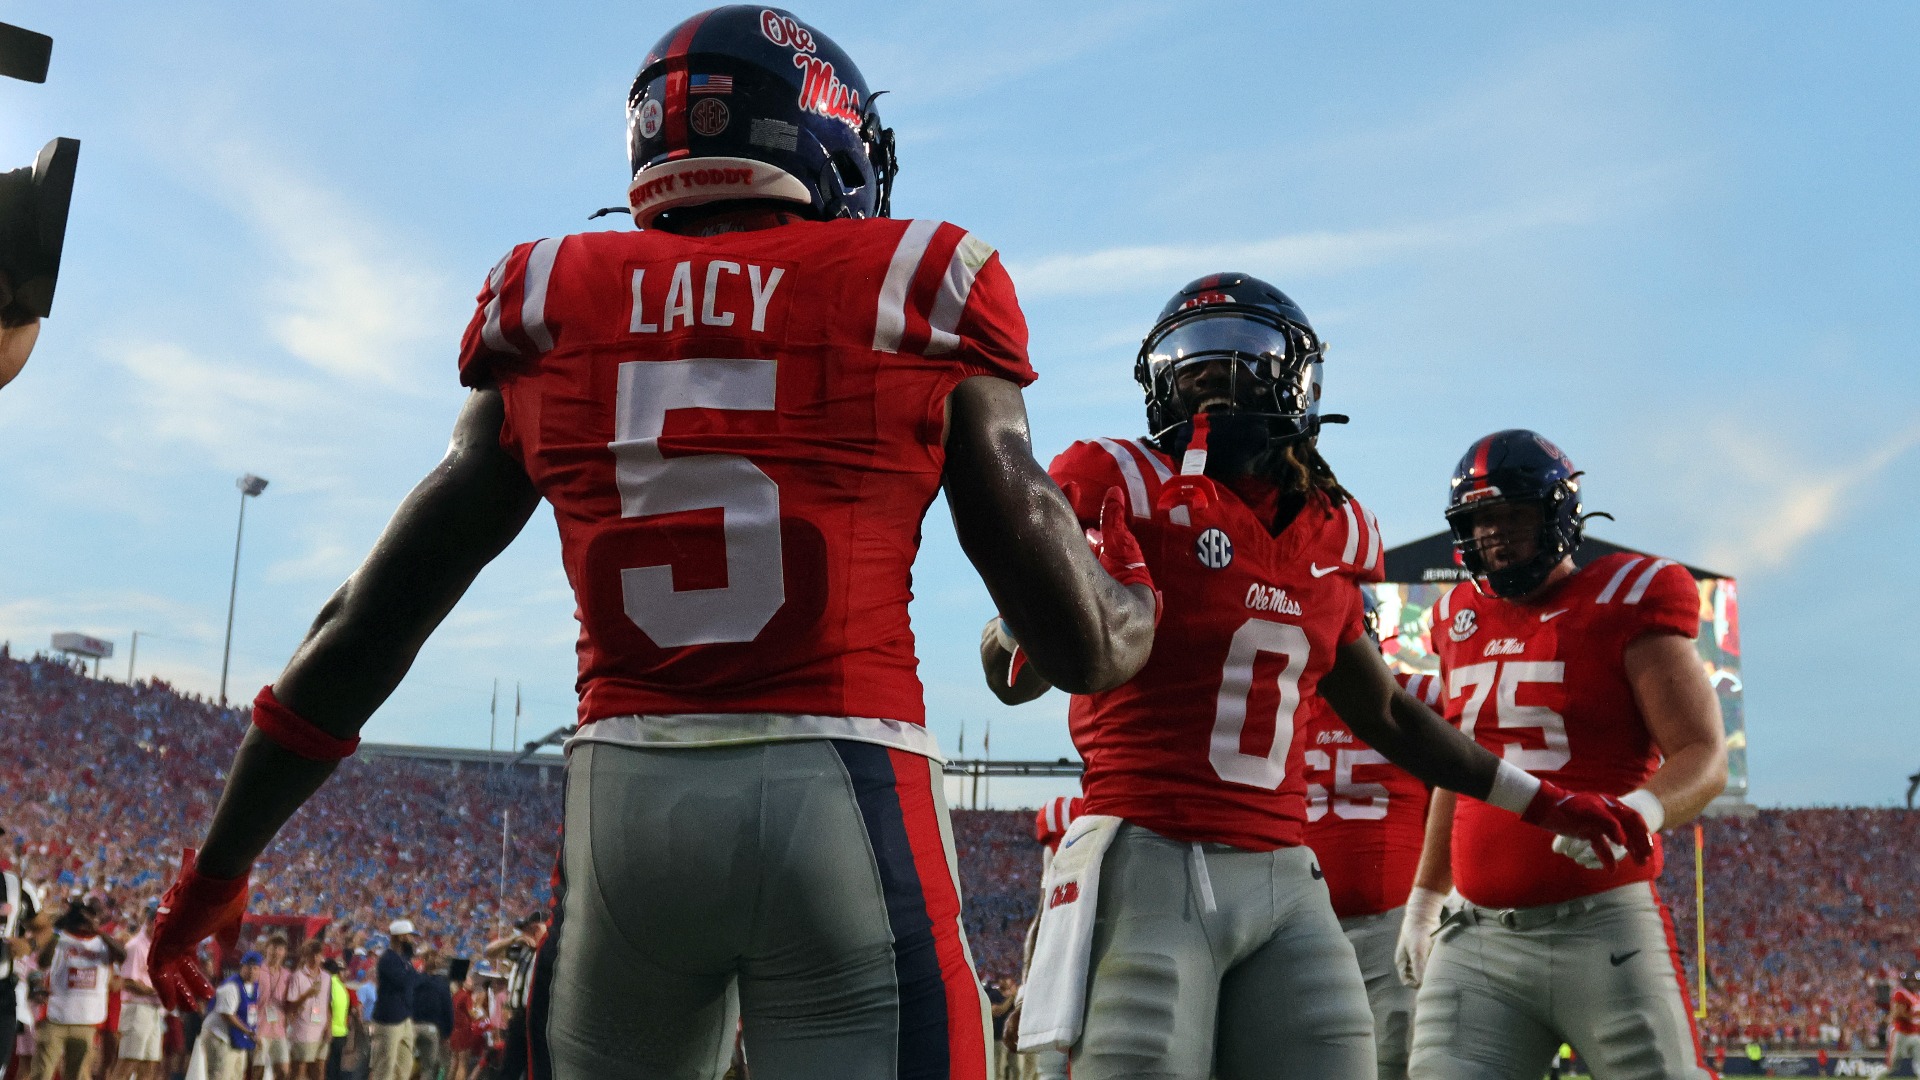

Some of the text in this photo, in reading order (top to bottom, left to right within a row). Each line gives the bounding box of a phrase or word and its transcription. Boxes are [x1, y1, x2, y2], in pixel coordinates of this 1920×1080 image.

[760, 9, 816, 53] Ole
[793, 53, 862, 128] Miss
[693, 99, 727, 135] SEC
[679, 168, 753, 188] TODDY
[629, 260, 786, 333] LACY
[607, 358, 786, 649] 5
[1197, 528, 1232, 569] SEC
[1245, 582, 1302, 616] Ole Miss
[1455, 609, 1476, 632] SEC
[1483, 637, 1525, 657] Ole Miss
[1208, 617, 1311, 791] 0
[1449, 661, 1572, 771] 75
[1316, 730, 1353, 745] Ole Miss
